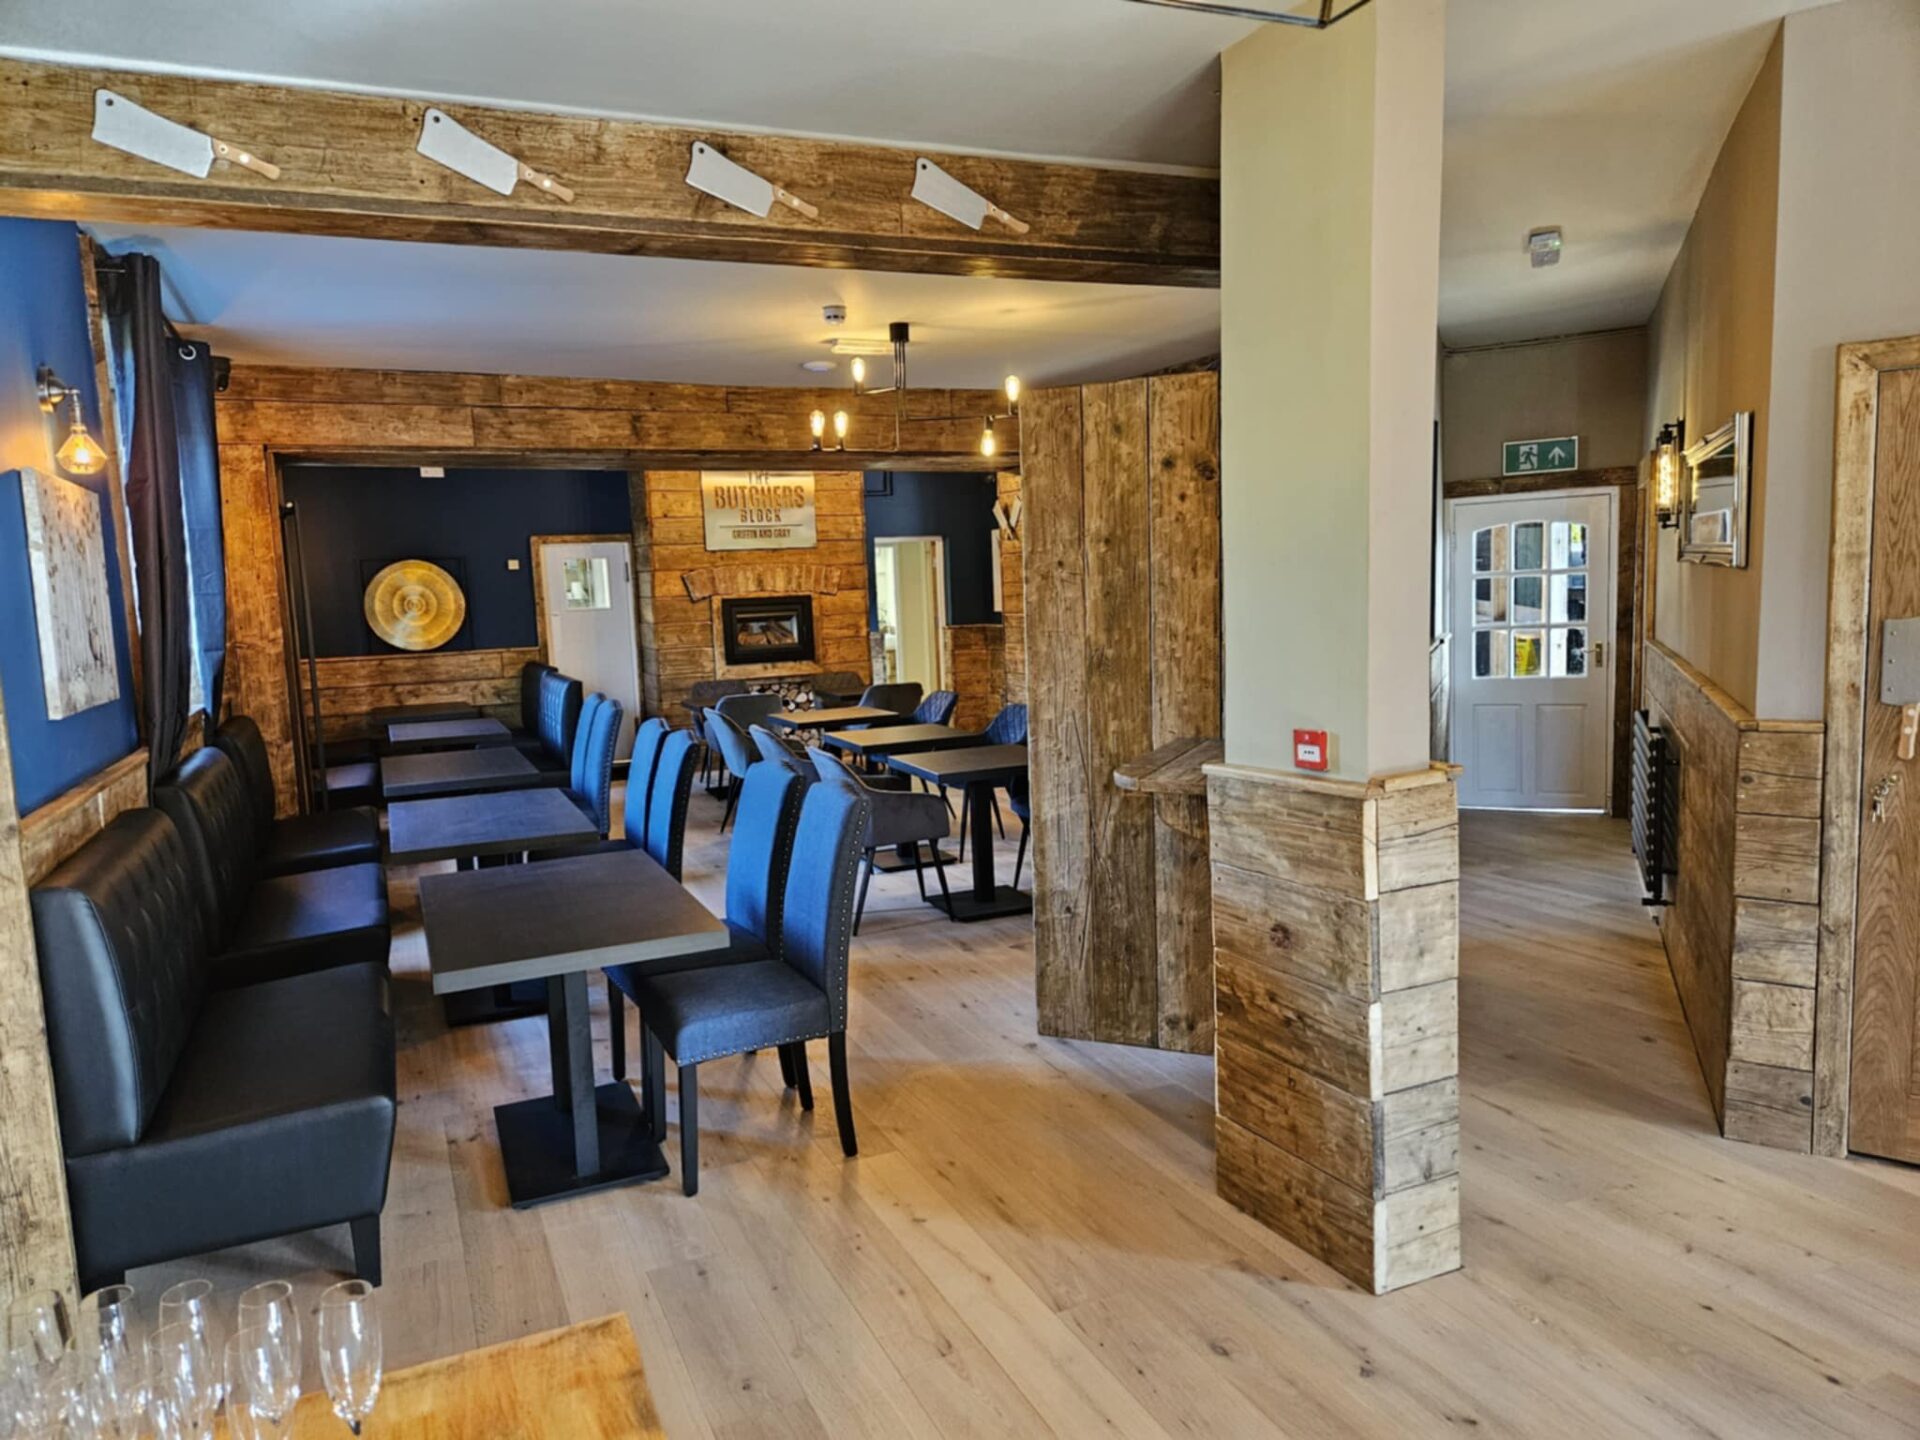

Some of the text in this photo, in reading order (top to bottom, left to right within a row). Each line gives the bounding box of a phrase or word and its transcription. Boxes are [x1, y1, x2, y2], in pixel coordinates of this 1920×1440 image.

[714, 486, 804, 508] BUTCHERS
[740, 509, 781, 523] BLOCK
[759, 529, 772, 538] AND
